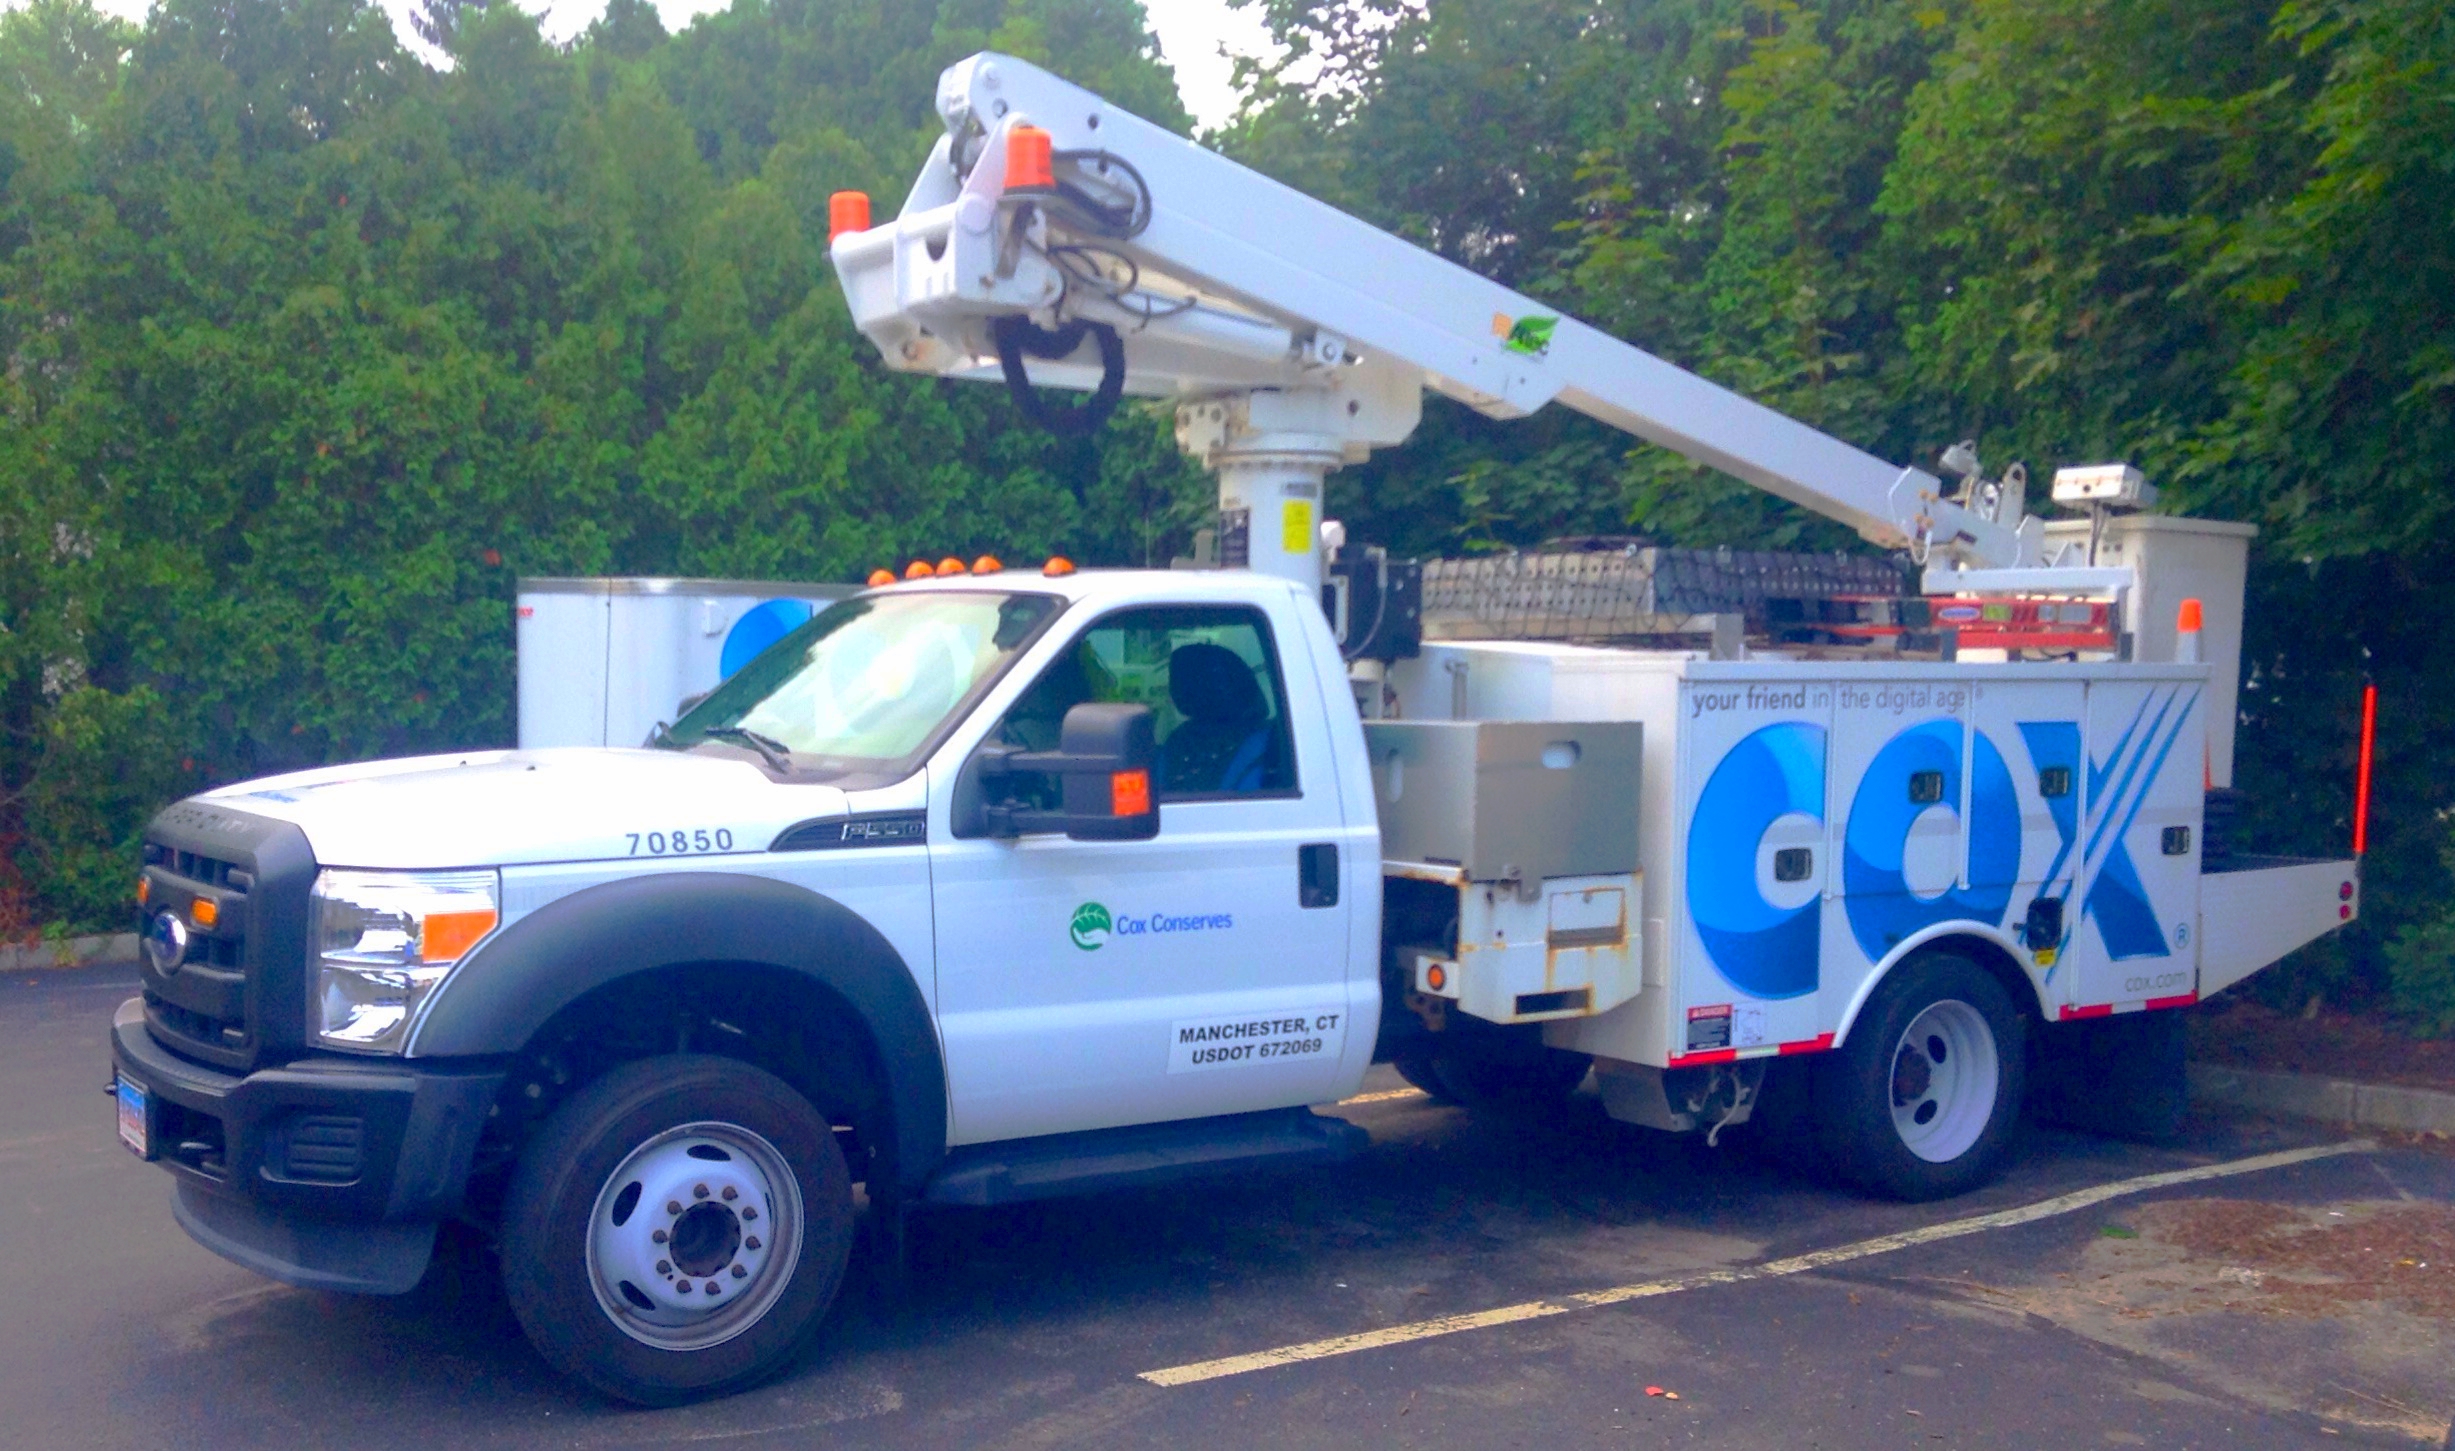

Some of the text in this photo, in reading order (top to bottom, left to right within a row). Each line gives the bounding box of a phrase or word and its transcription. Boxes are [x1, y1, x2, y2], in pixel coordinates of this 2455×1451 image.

[1692, 685, 1965, 718] your friend in the digital age
[625, 828, 733, 856] 70850
[1117, 913, 1232, 935] Cox Conserves
[2125, 971, 2187, 992] cox.com
[1179, 1015, 1339, 1043] MANCHESTER, CT
[1192, 1038, 1322, 1065] USDOT 672069
